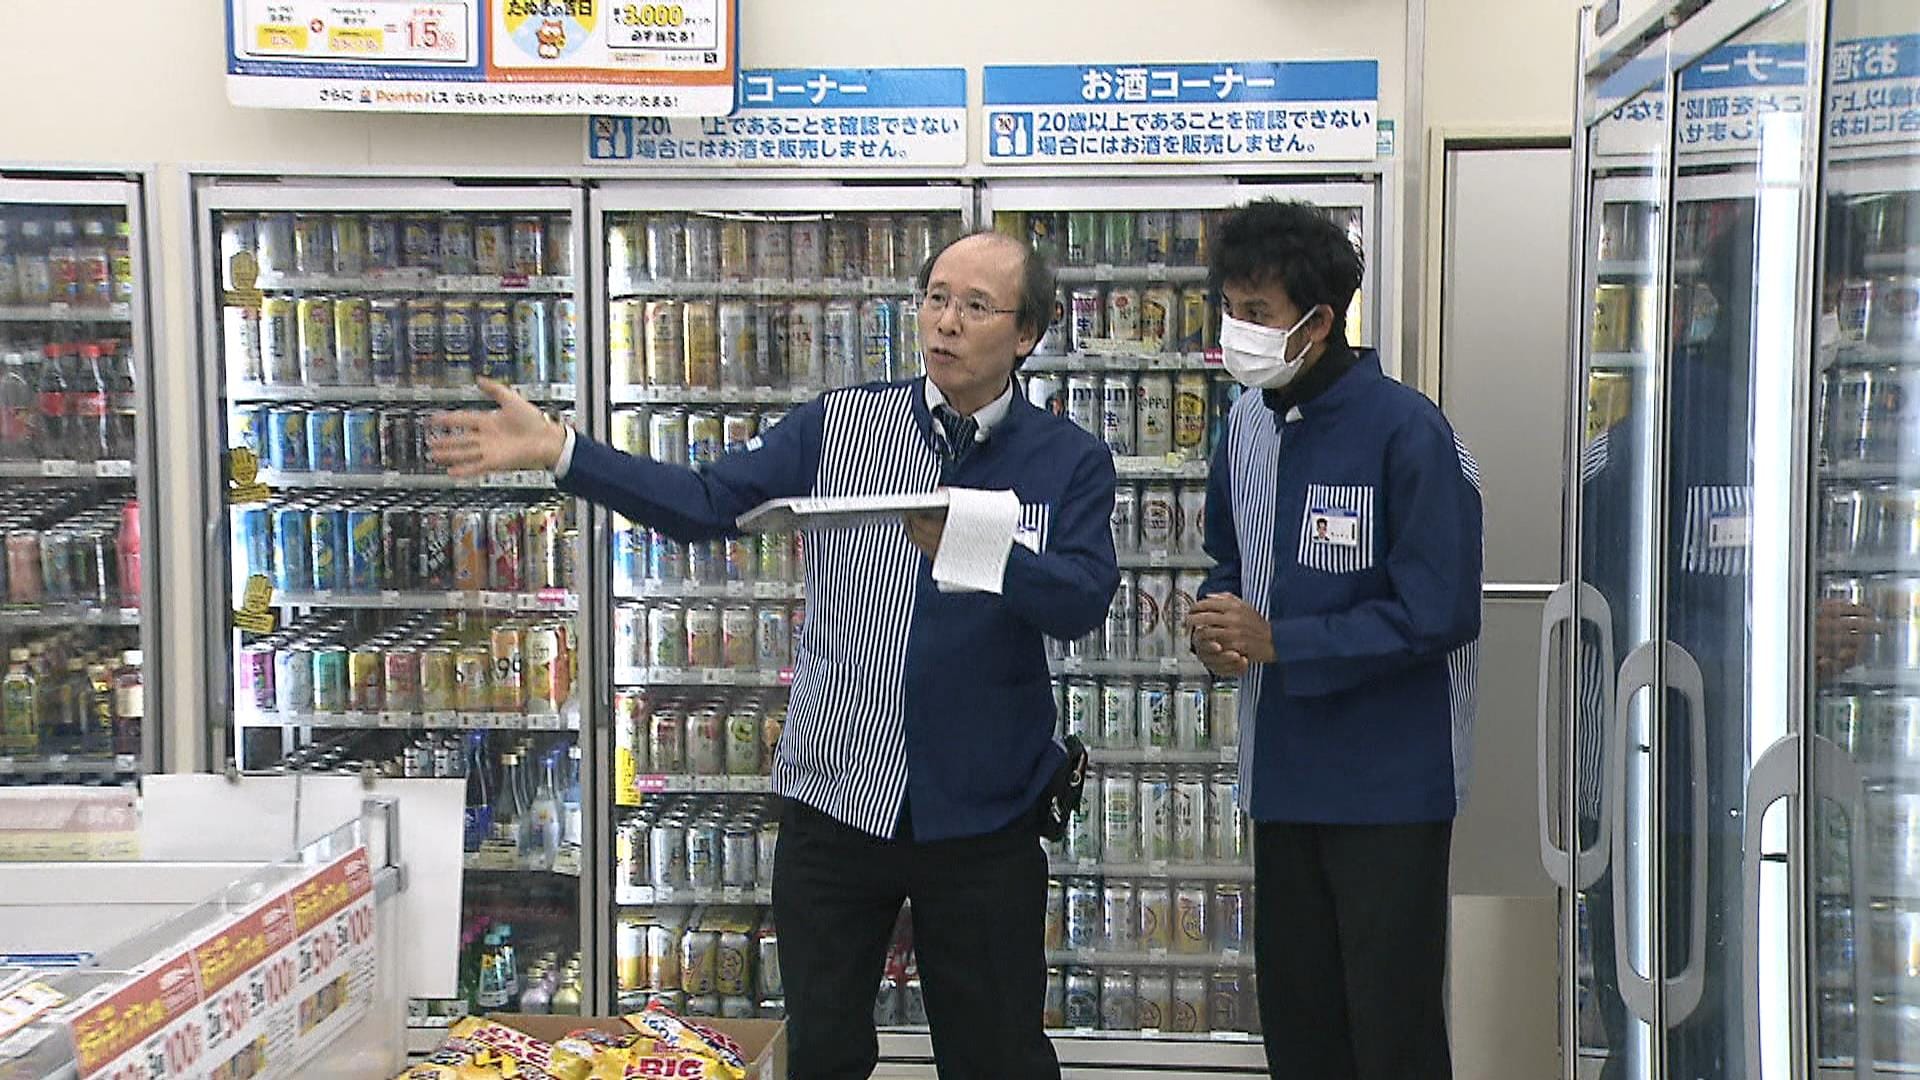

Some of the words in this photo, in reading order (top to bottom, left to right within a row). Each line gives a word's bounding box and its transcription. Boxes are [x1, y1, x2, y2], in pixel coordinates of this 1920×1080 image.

[1081, 67, 1275, 101] お酒コーナー
[1038, 111, 1371, 133] 20歳以上であることを確認できない
[636, 140, 908, 160] 場合にはお酒を販売しません。
[1037, 135, 1316, 156] 場合にはお酒を販売しません。
